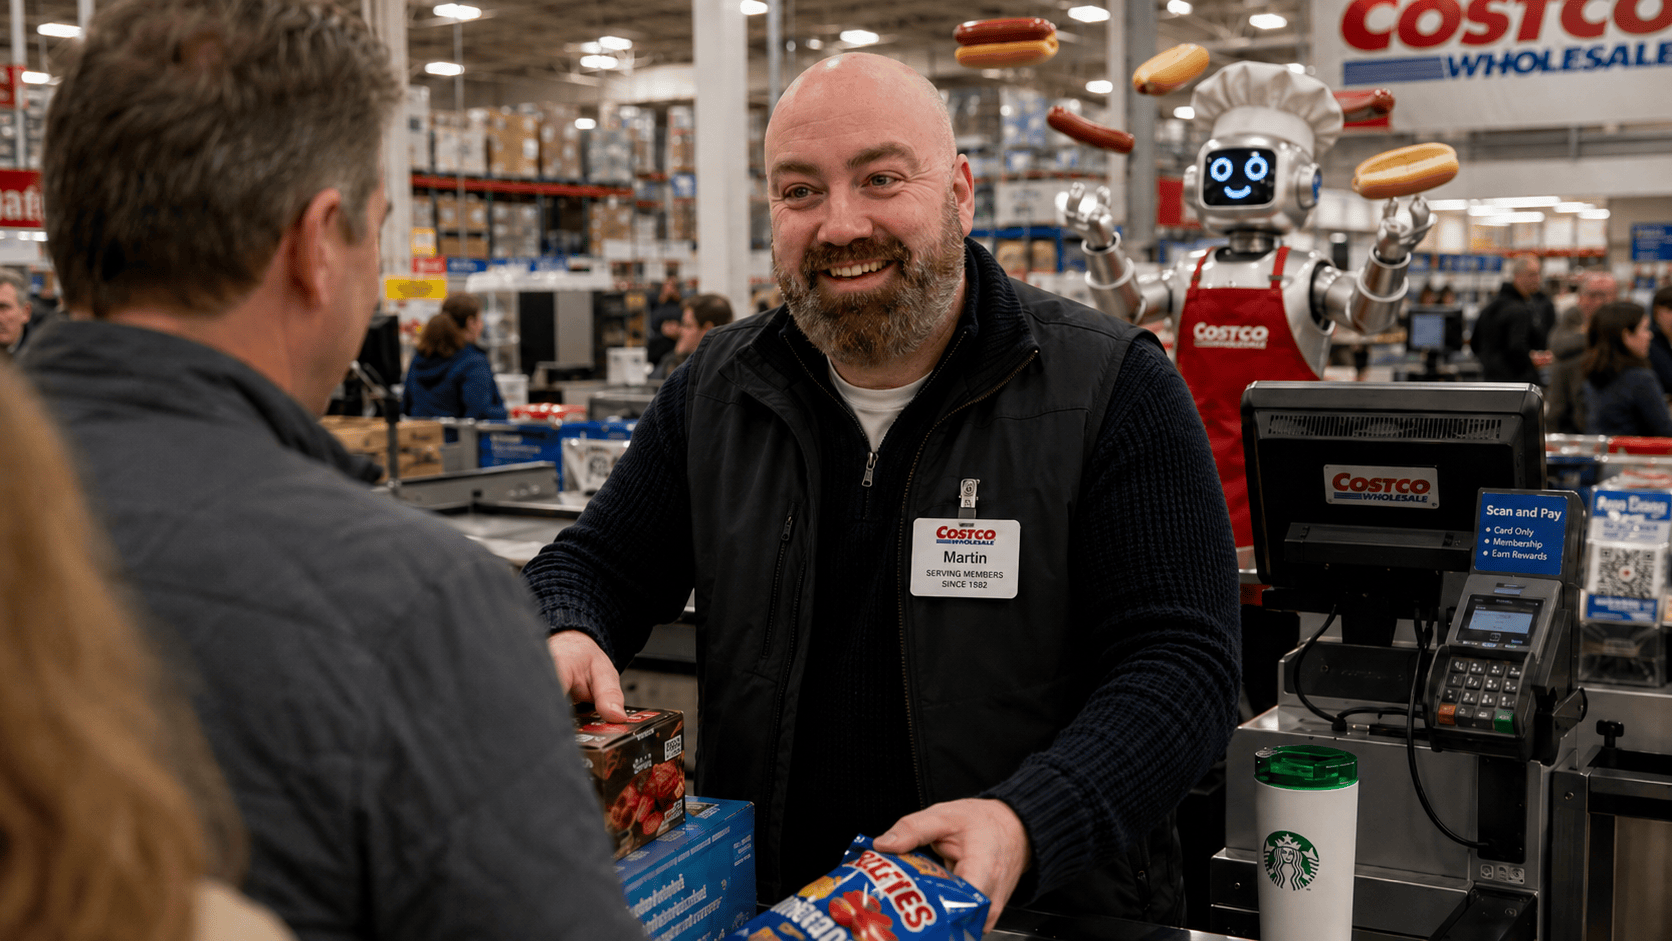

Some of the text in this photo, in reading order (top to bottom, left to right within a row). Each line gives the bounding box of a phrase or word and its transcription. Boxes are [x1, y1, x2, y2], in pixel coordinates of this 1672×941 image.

[1341, 0, 1672, 51] COSTCO
[1447, 42, 1672, 78] WHOLESALE
[1193, 321, 1269, 341] COSTCO
[1332, 472, 1430, 494] COSTCO
[1362, 493, 1428, 503] WHOLESALE
[1486, 505, 1562, 522] Scan and Pay
[936, 526, 997, 540] COSTCO
[1494, 526, 1534, 537] Card Only
[1493, 538, 1543, 550] Membership
[943, 551, 987, 564] Martin
[1492, 549, 1548, 561] Earn Rewards
[926, 569, 1004, 579] SERVING MEMBERS
[942, 580, 966, 588] SINCE
